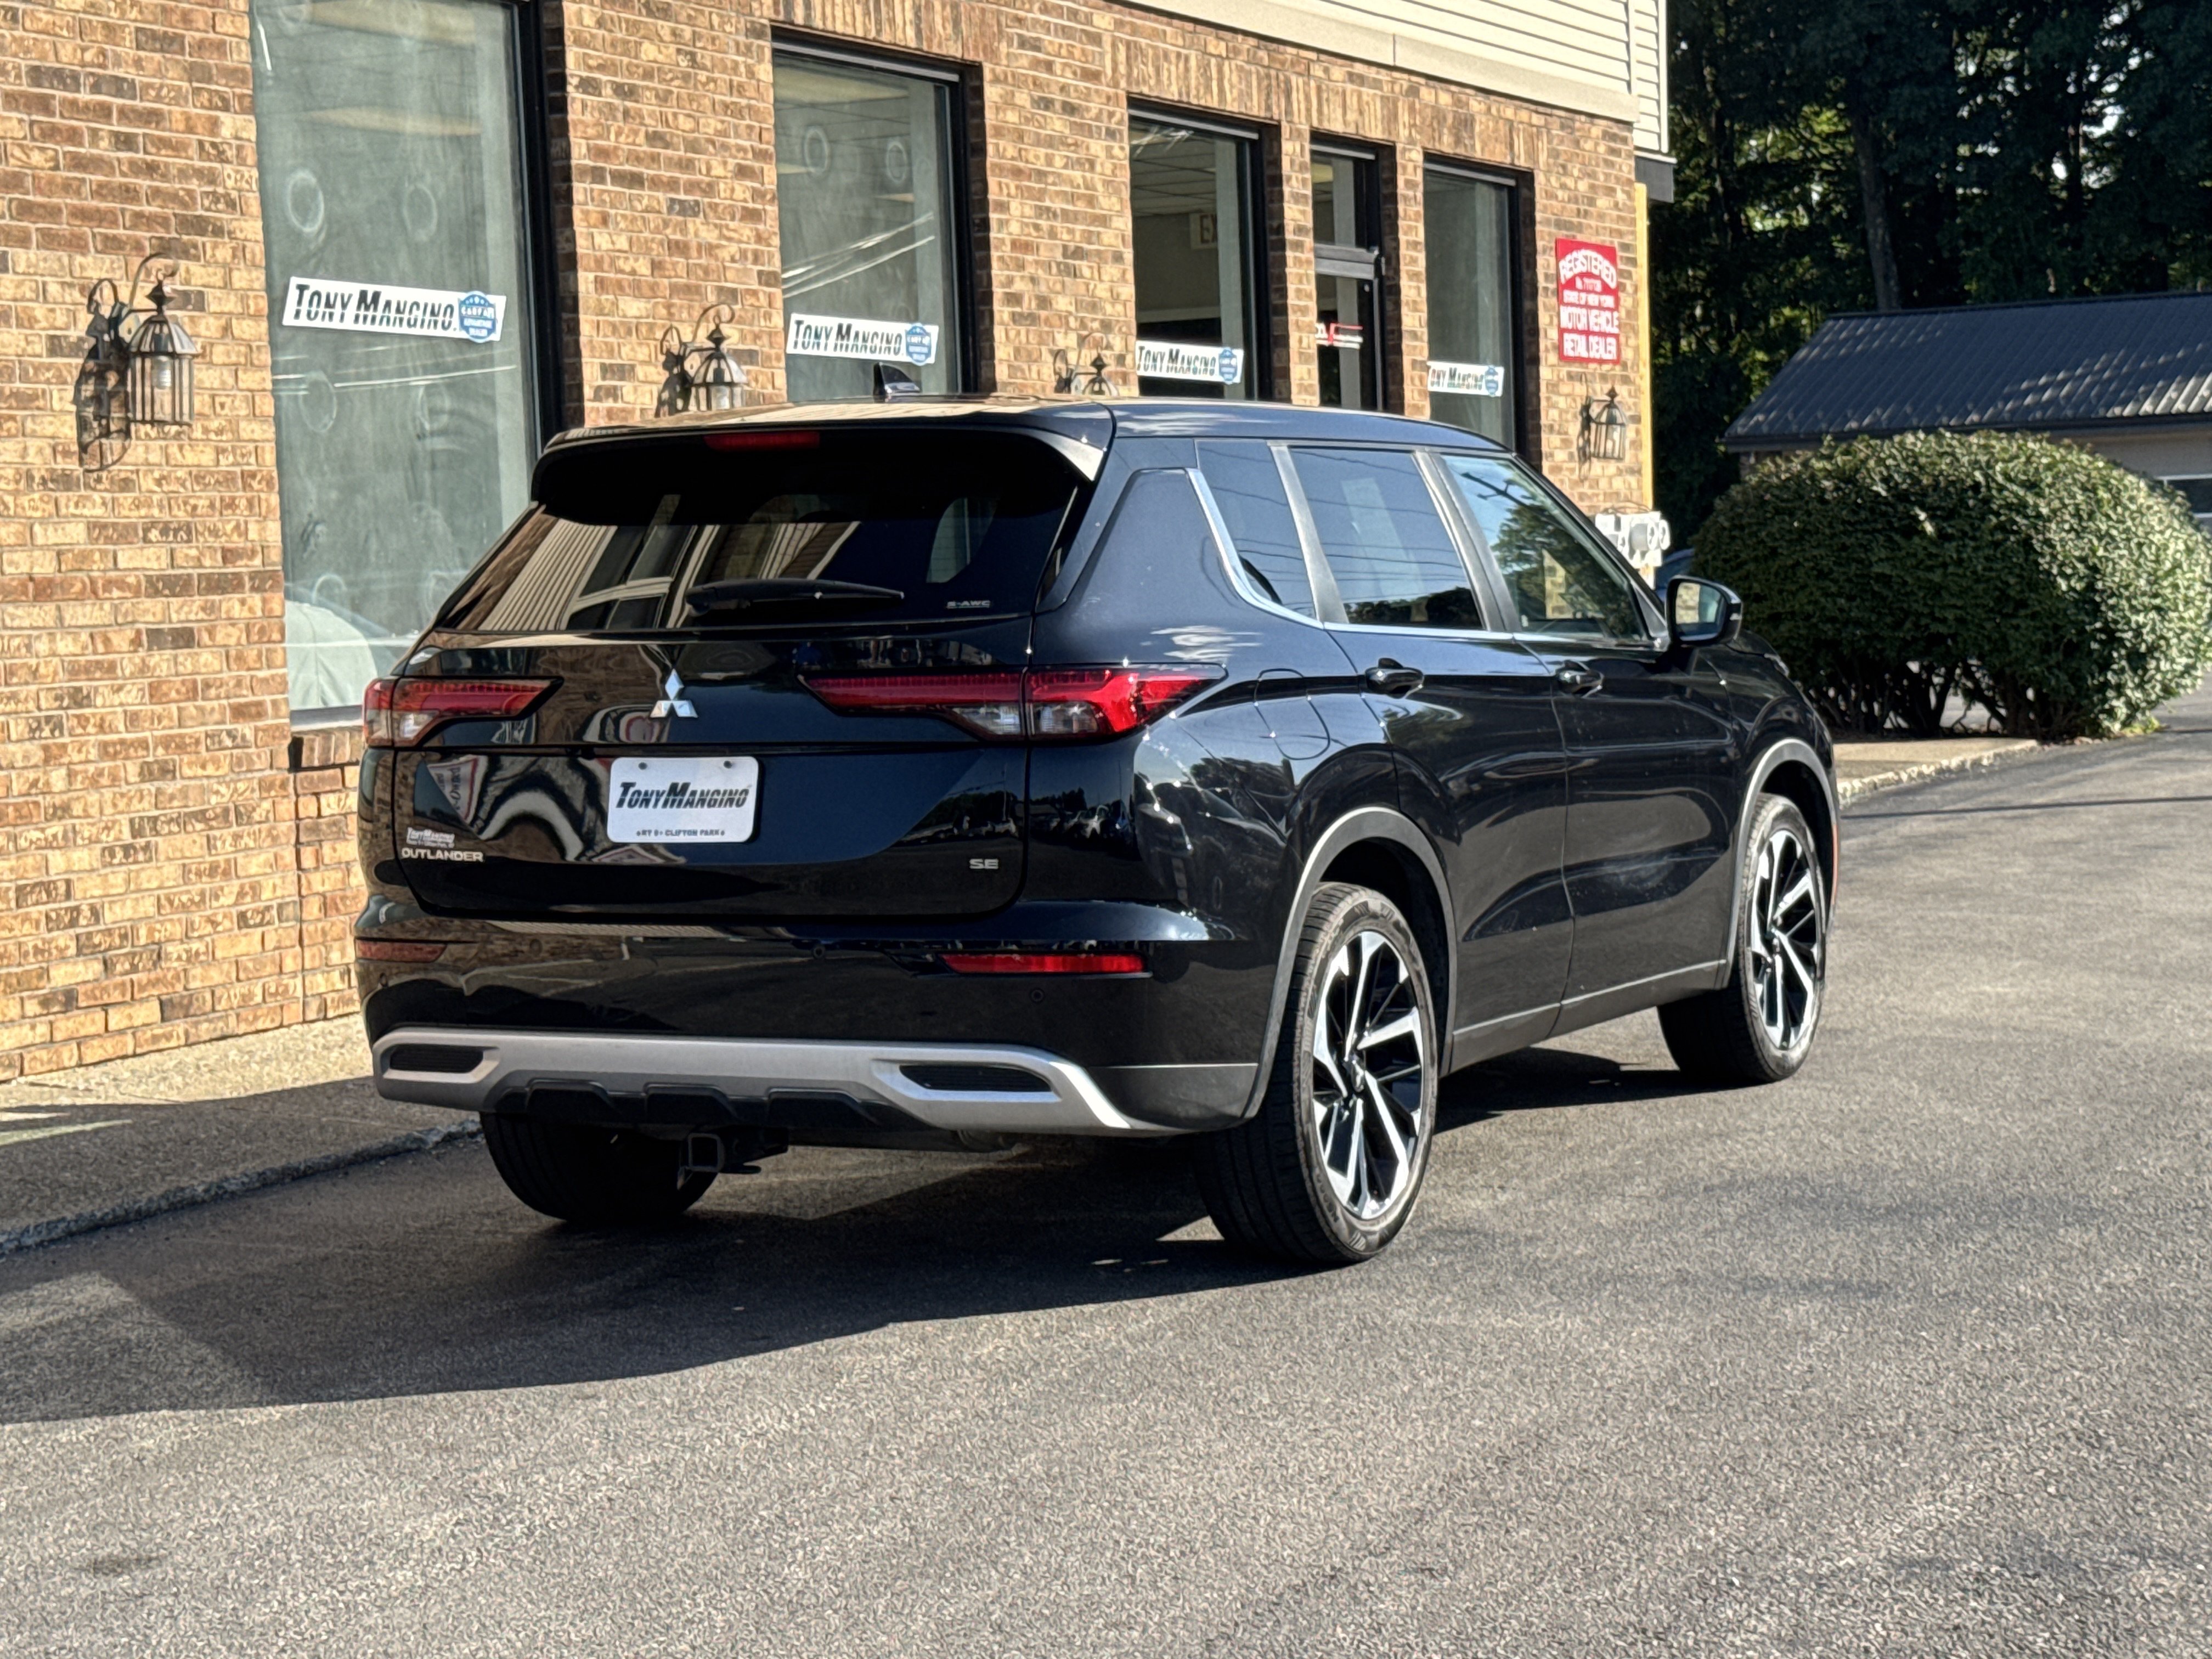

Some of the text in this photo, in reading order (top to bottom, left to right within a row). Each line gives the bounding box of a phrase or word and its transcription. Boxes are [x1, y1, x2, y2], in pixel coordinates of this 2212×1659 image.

[1559, 249, 1617, 289] REGISTERED
[294, 284, 352, 323] TONY
[1560, 305, 1620, 334] MOTOR VEHICLE
[793, 320, 833, 352] TONY
[1563, 333, 1617, 360] RETAIL DEALER
[1137, 346, 1165, 373] TONY
[1427, 365, 1446, 387] ONY
[402, 848, 484, 862] OUTLANDER
[969, 859, 998, 869] SE
